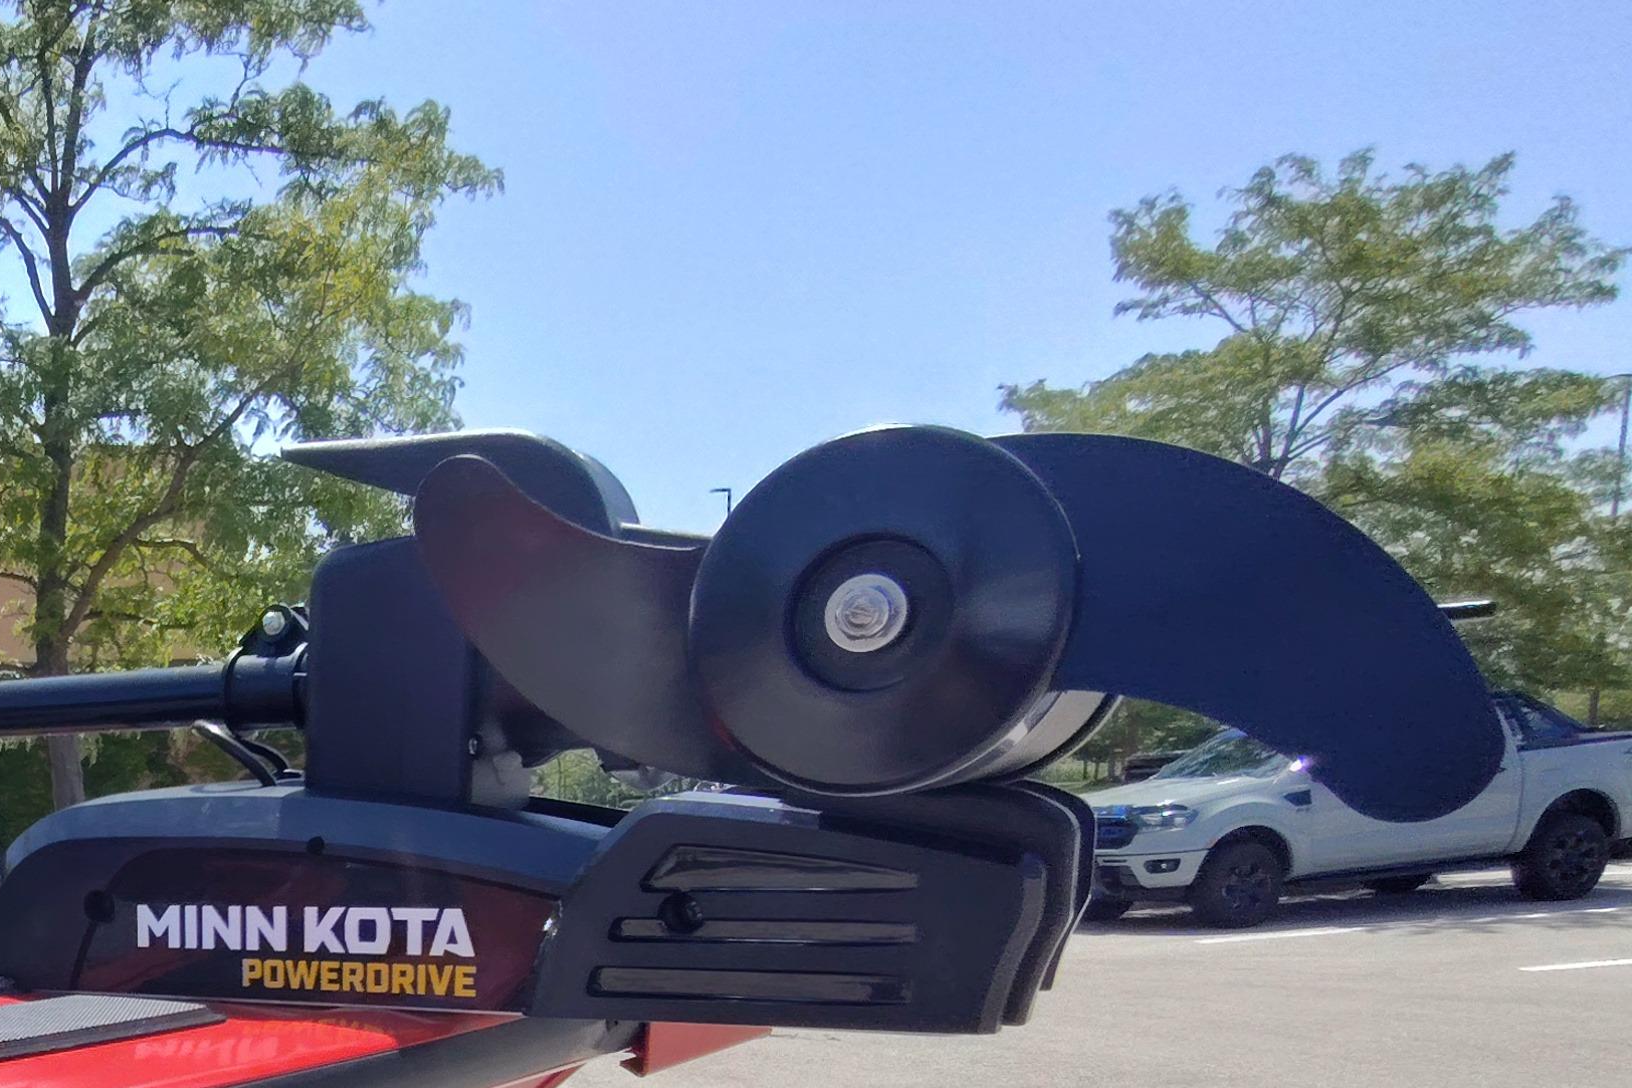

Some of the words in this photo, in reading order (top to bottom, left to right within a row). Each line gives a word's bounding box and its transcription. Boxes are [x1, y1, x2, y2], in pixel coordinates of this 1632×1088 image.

[136, 904, 287, 951] MINN
[303, 906, 475, 957] KOTA
[242, 959, 477, 998] POWERDRIVE
